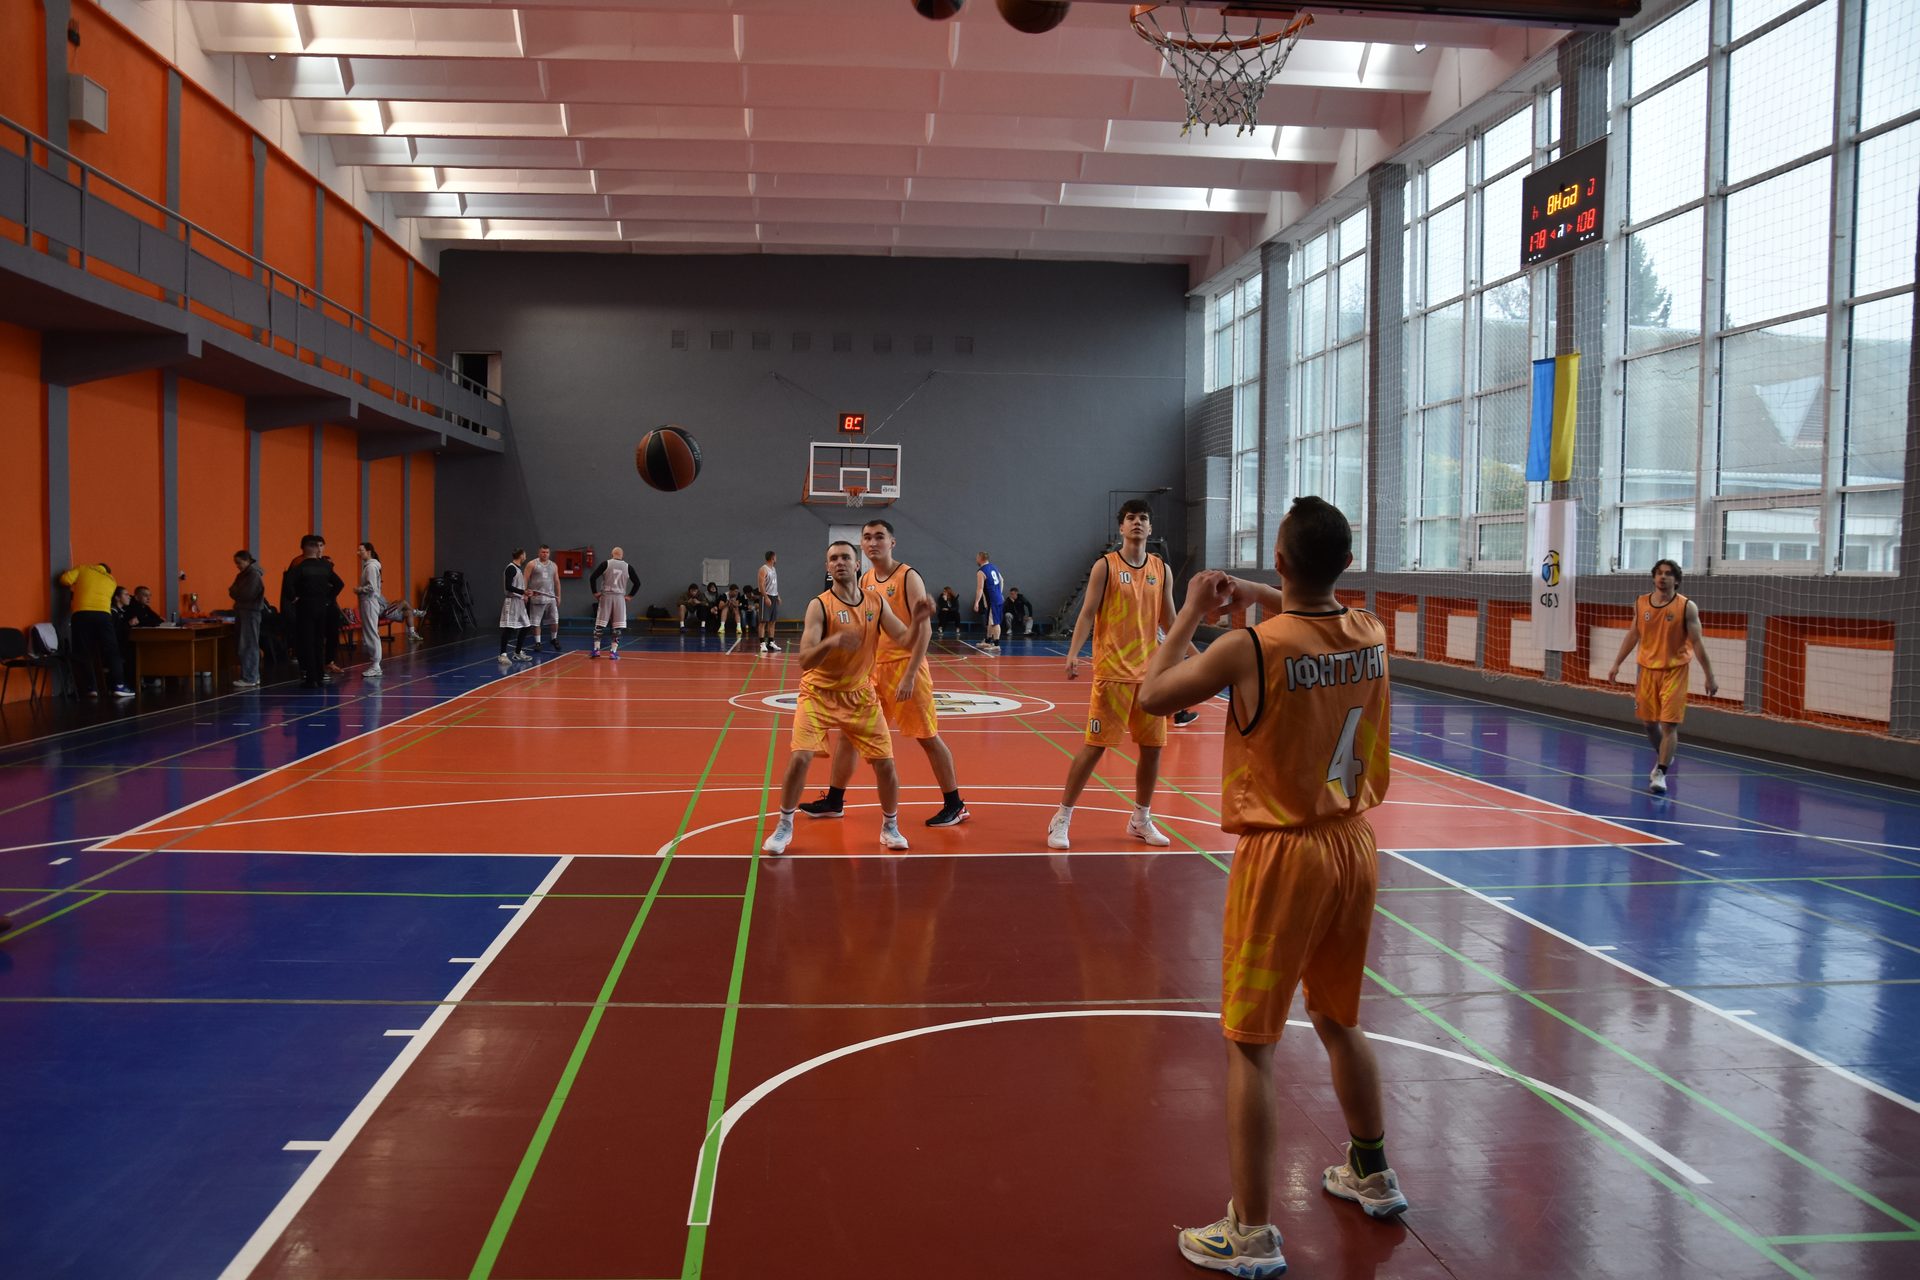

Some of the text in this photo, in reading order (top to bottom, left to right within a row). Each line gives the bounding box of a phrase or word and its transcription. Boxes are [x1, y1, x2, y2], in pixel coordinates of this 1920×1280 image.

[613, 569, 623, 585] 7
[991, 570, 1000, 585] 9
[1119, 570, 1131, 584] 10
[837, 609, 850, 624] 11
[1089, 719, 1101, 733] 10
[1326, 706, 1364, 799] 4
